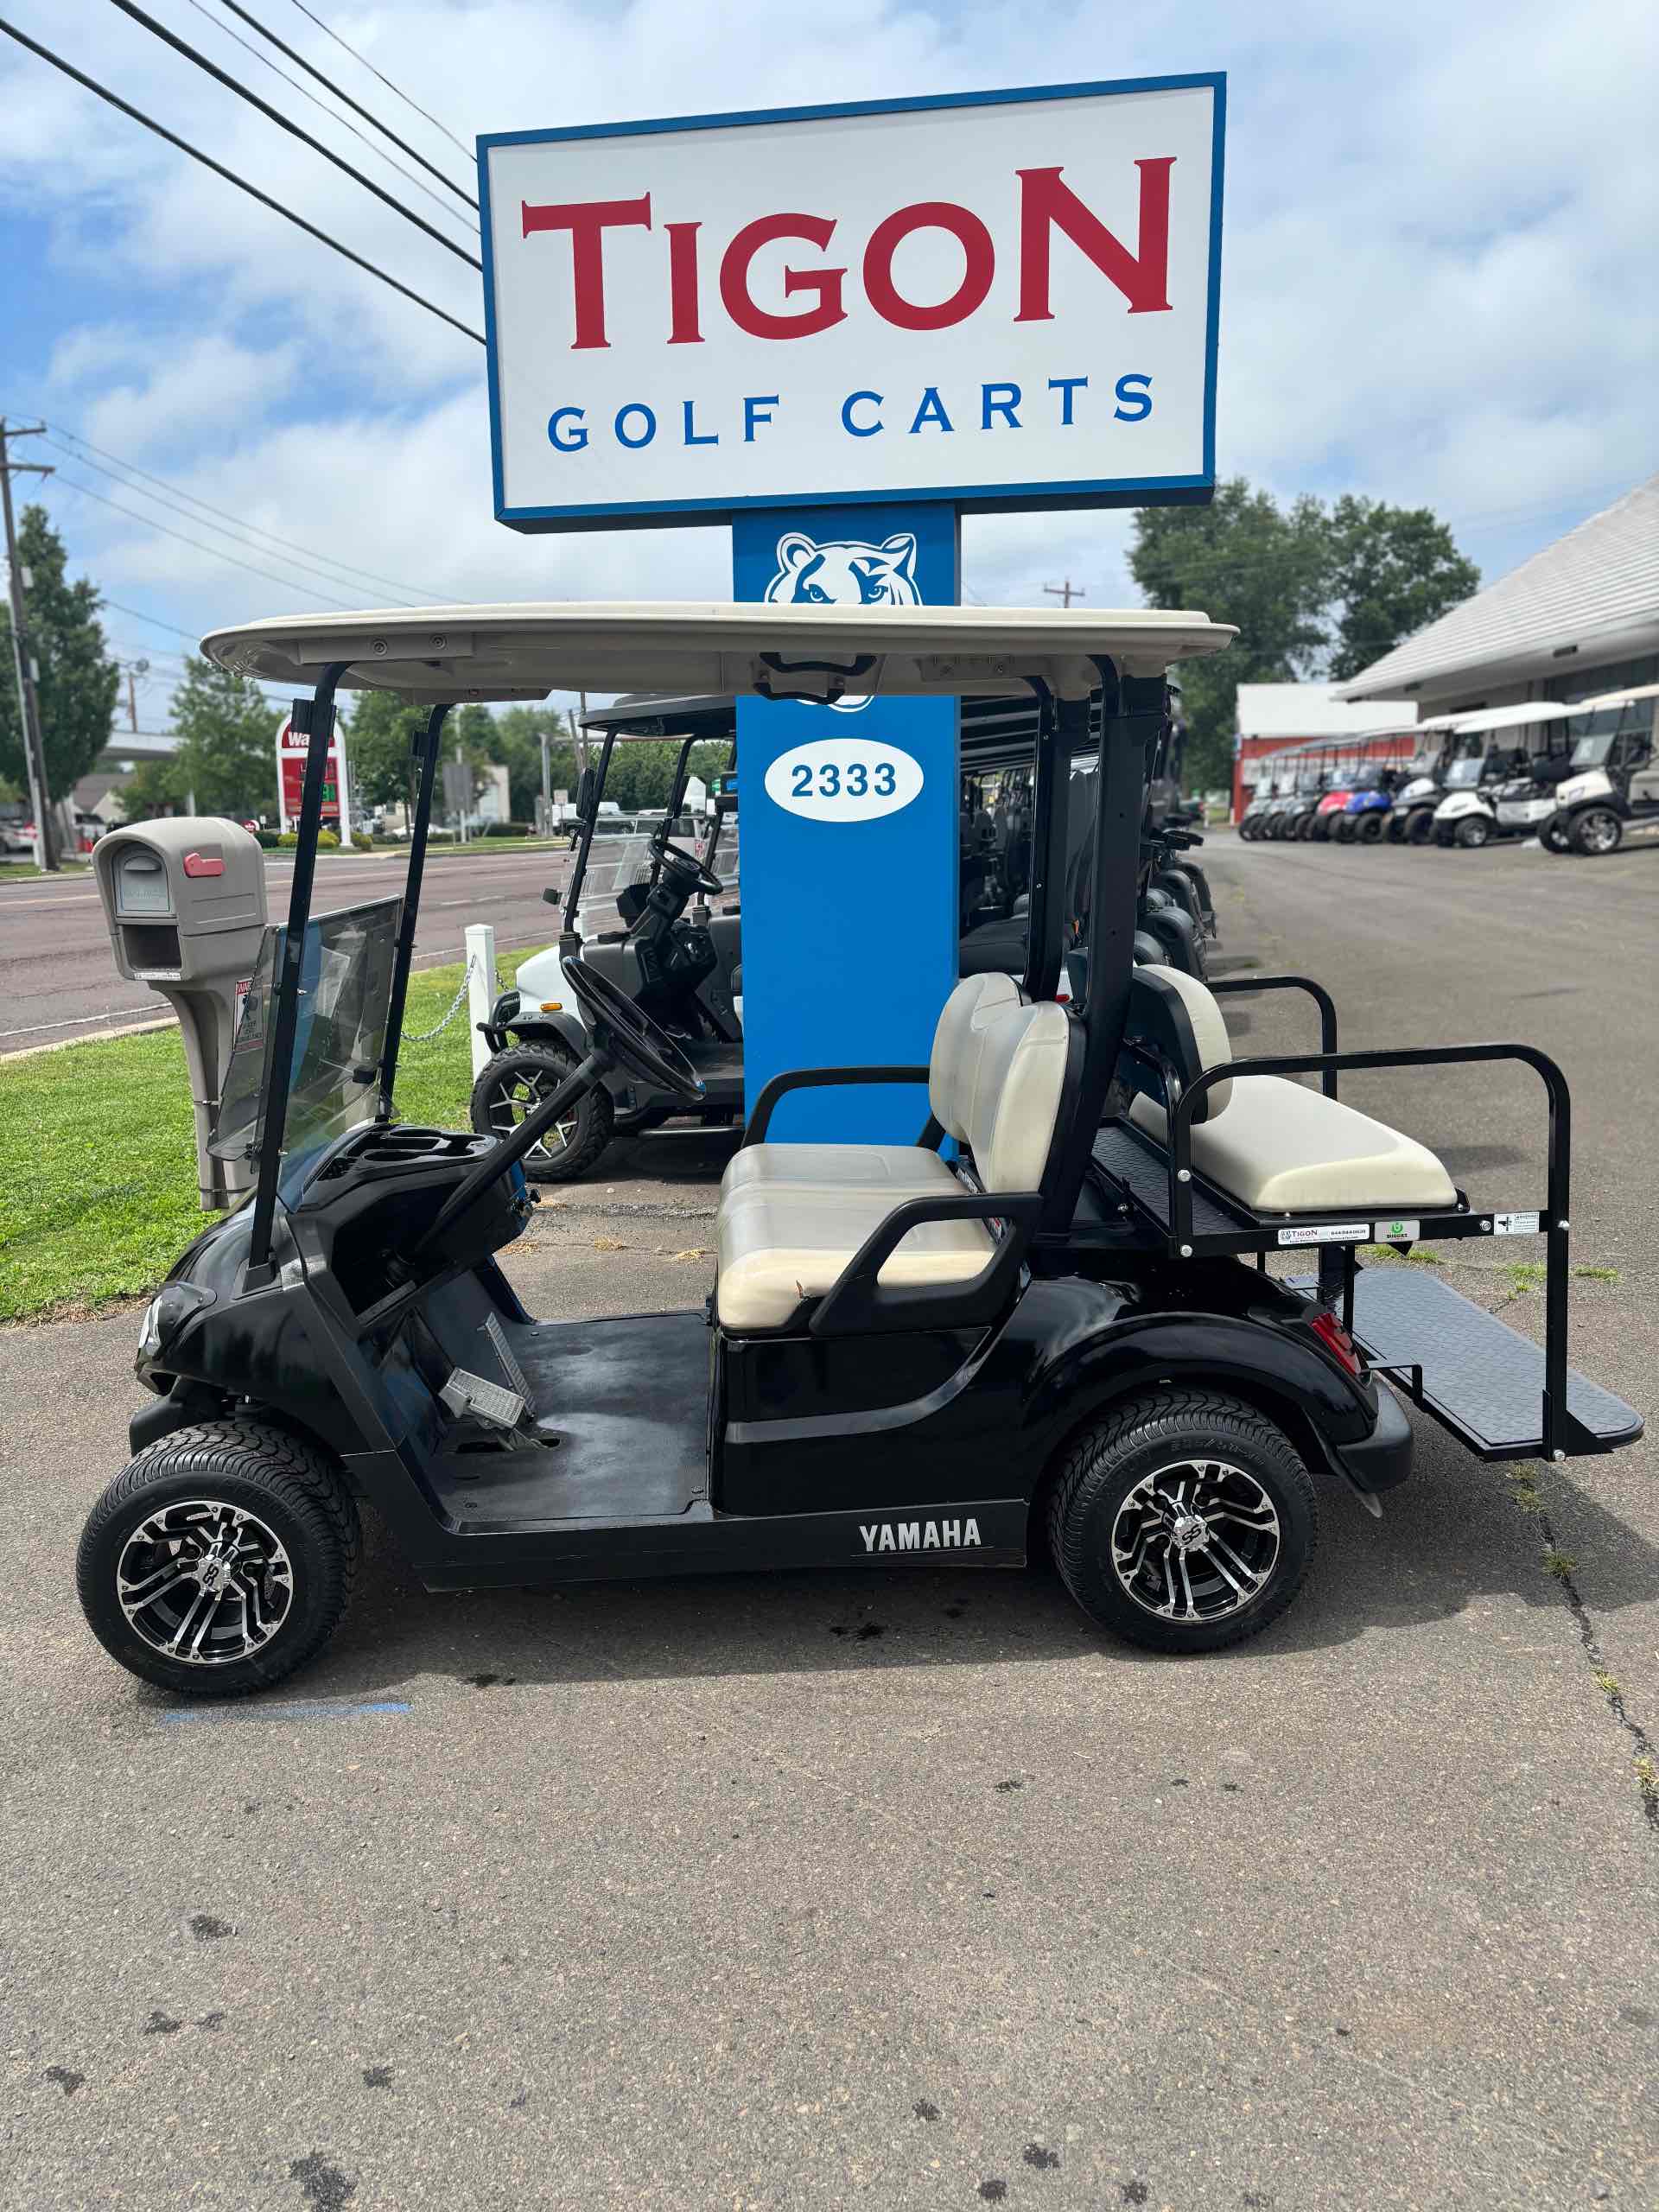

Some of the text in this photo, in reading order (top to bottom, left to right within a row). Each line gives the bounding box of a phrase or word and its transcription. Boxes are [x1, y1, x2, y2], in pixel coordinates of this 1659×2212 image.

[520, 156, 1177, 350] TIGON
[548, 374, 1154, 453] GOLF CARTS
[791, 763, 897, 798] 2333
[858, 1518, 982, 1552] YAMAHA
